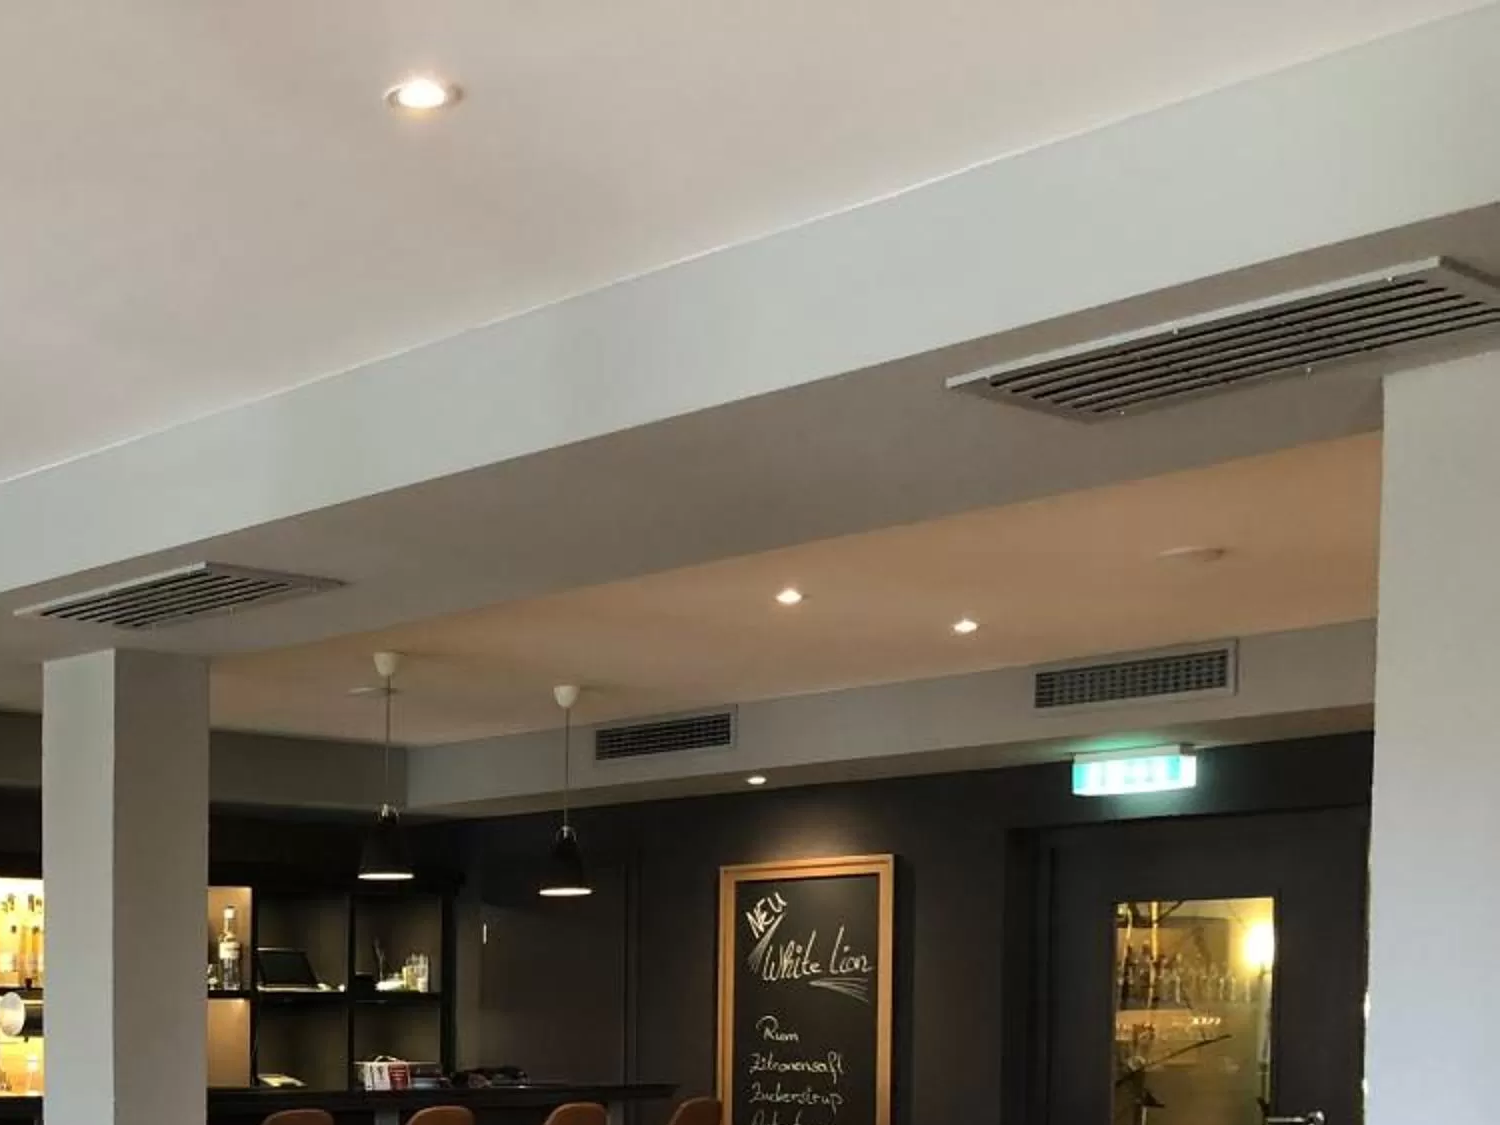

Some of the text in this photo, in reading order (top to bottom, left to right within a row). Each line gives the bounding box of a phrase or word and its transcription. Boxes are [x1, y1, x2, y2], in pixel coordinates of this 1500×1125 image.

[745, 891, 788, 939] NEU
[762, 924, 873, 981] White Lion
[756, 1015, 799, 1042] Rum
[749, 1051, 844, 1084] Zitronensaft
